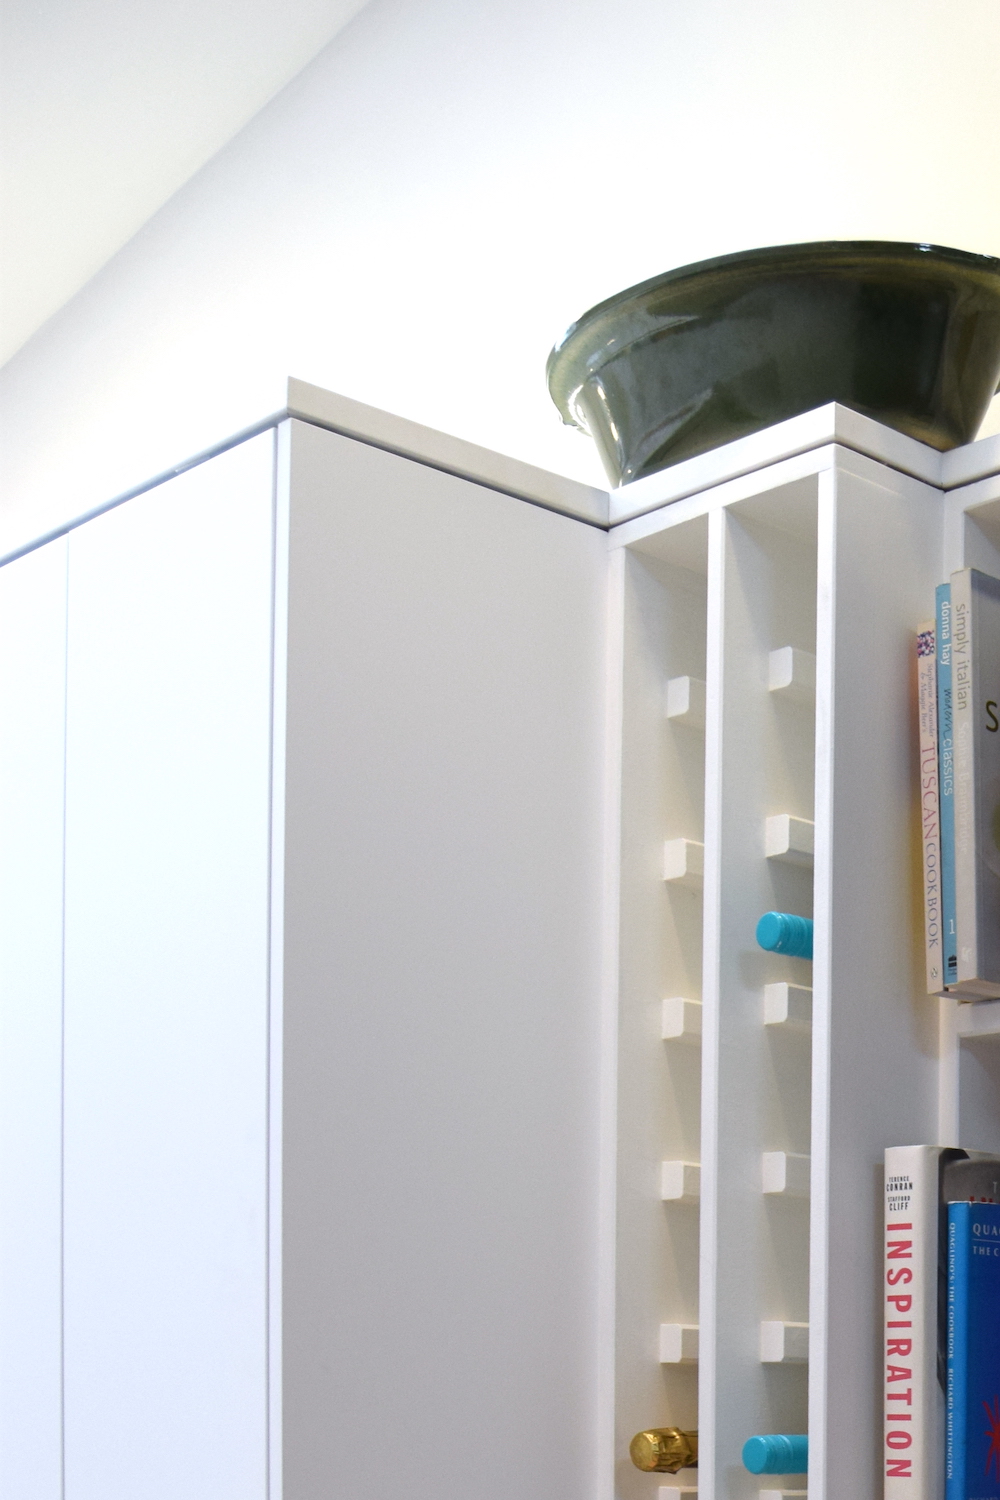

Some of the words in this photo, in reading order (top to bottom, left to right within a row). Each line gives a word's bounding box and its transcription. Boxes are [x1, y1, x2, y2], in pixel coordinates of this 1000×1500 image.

[941, 601, 952, 640] donna
[953, 603, 969, 655] simply
[940, 643, 952, 666] hay
[957, 660, 969, 711] italian
[943, 739, 953, 796] classics
[921, 742, 937, 840] TUSCAN
[886, 1182, 913, 1191] CONRAN
[889, 1202, 909, 1211] CLIFF
[972, 1246, 991, 1256] THE
[886, 1223, 913, 1477] INSPIRATION
